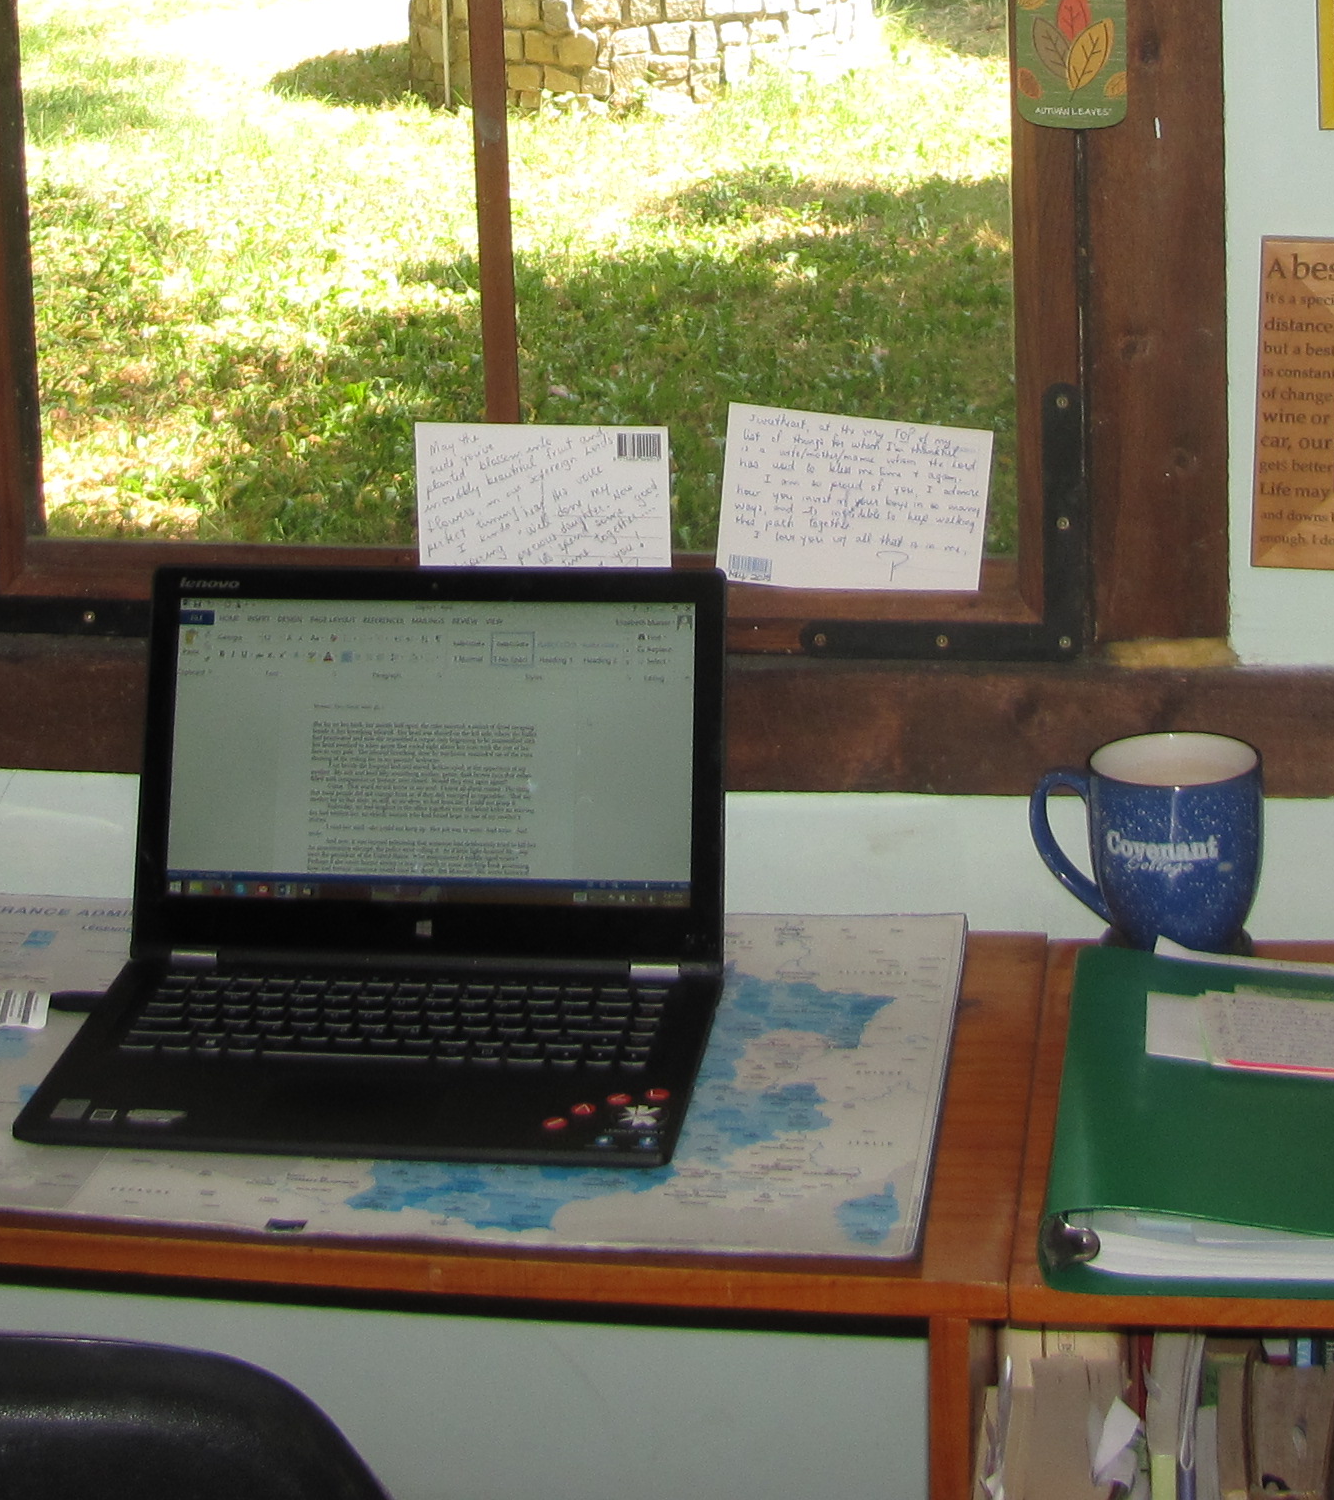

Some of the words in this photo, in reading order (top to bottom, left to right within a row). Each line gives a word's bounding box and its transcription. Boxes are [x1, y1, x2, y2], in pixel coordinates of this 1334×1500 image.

[1034, 107, 1071, 116] AUTUMN
[1267, 258, 1287, 279] A
[1266, 292, 1285, 304] It's
[1289, 296, 1296, 304] a
[1263, 343, 1288, 355] but
[1294, 346, 1301, 355] a
[1262, 367, 1273, 377] is
[1261, 387, 1275, 399] of
[1262, 410, 1307, 424] wine
[1310, 412, 1331, 424] or
[429, 441, 457, 457] May
[1260, 437, 1292, 451] car,
[1298, 437, 1334, 450] our
[1259, 461, 1288, 474] gets
[1292, 460, 1333, 473] better
[1259, 482, 1291, 497] Life
[1295, 487, 1331, 501] may
[1261, 509, 1283, 521] and
[1286, 510, 1328, 522] downs
[799, 533, 824, 546] you
[1259, 533, 1306, 548] enough.
[1311, 534, 1317, 545] I
[180, 576, 240, 589] lenovo
[1106, 829, 1219, 861] Covenant
[1126, 858, 1194, 878] College
